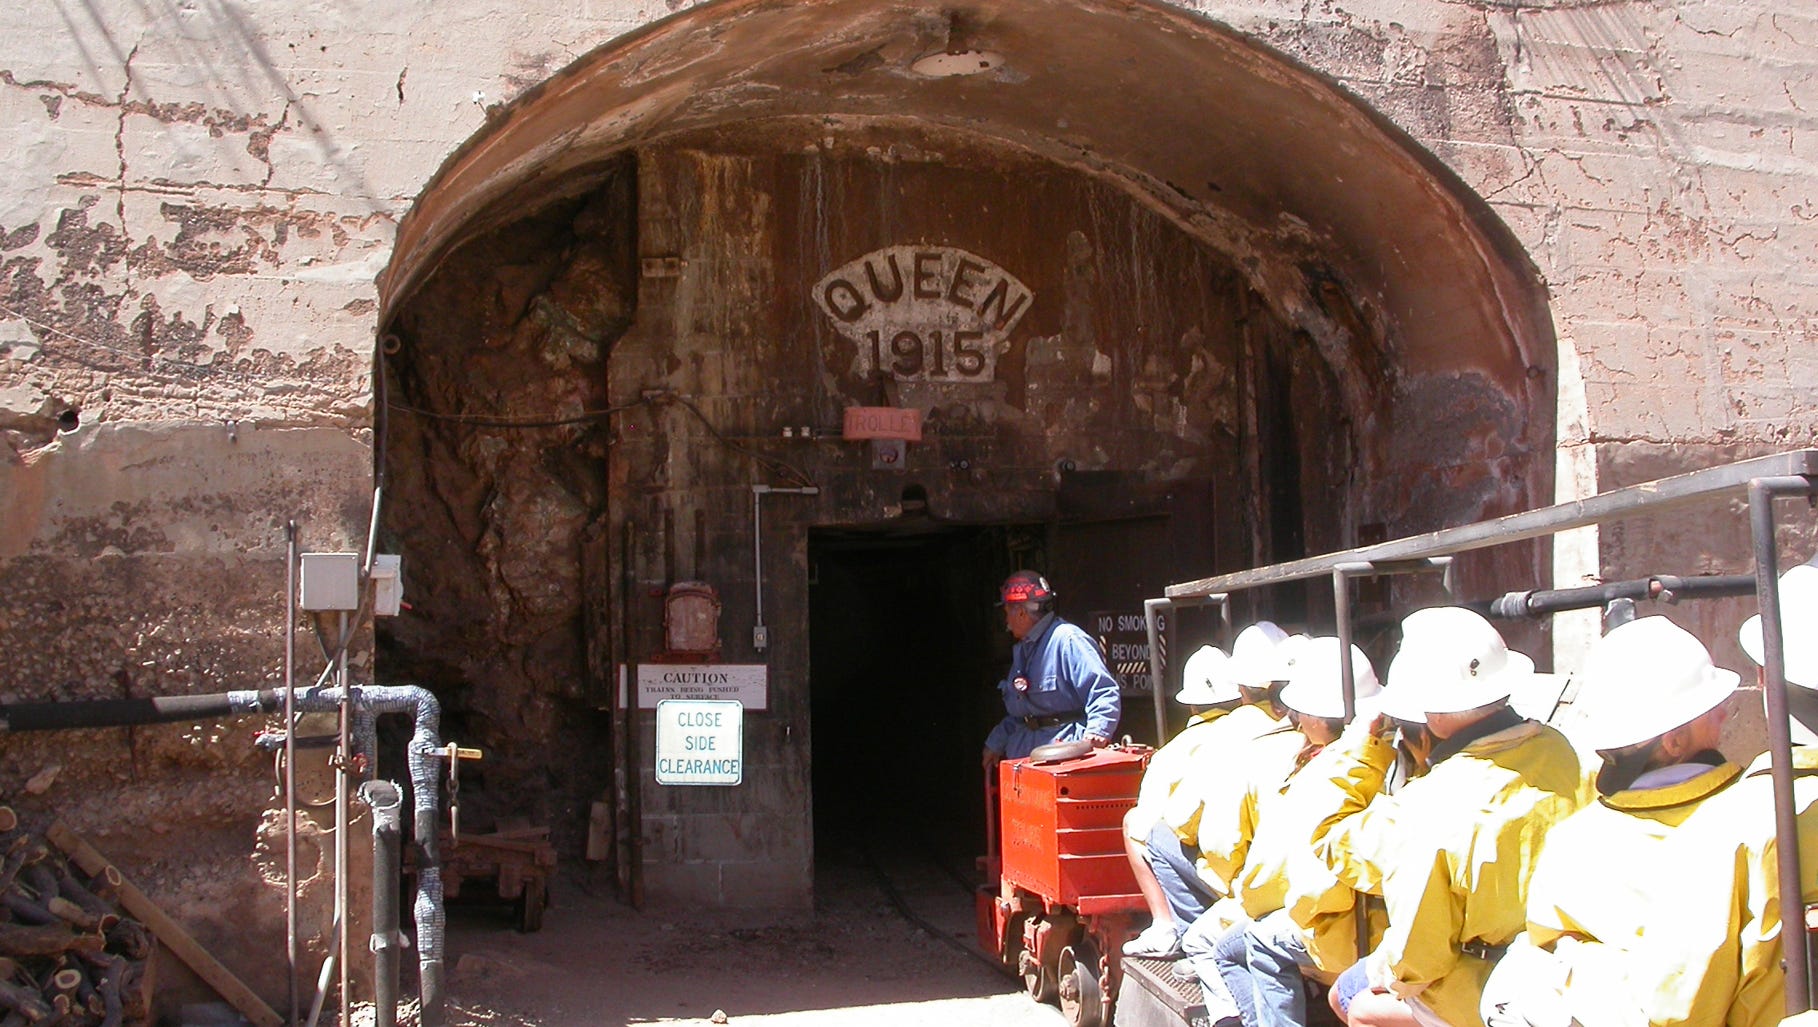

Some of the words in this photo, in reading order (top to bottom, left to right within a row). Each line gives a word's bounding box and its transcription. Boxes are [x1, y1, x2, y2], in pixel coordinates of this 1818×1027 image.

[824, 252, 1029, 331] QUEEN
[866, 329, 986, 377] 1915
[1099, 616, 1113, 632] NO
[1118, 615, 1165, 631] SMOKG
[663, 672, 729, 683] CAUTION
[678, 712, 722, 727] CLOSE
[685, 736, 716, 750] SIDE
[659, 758, 740, 775] CLEARANCE
